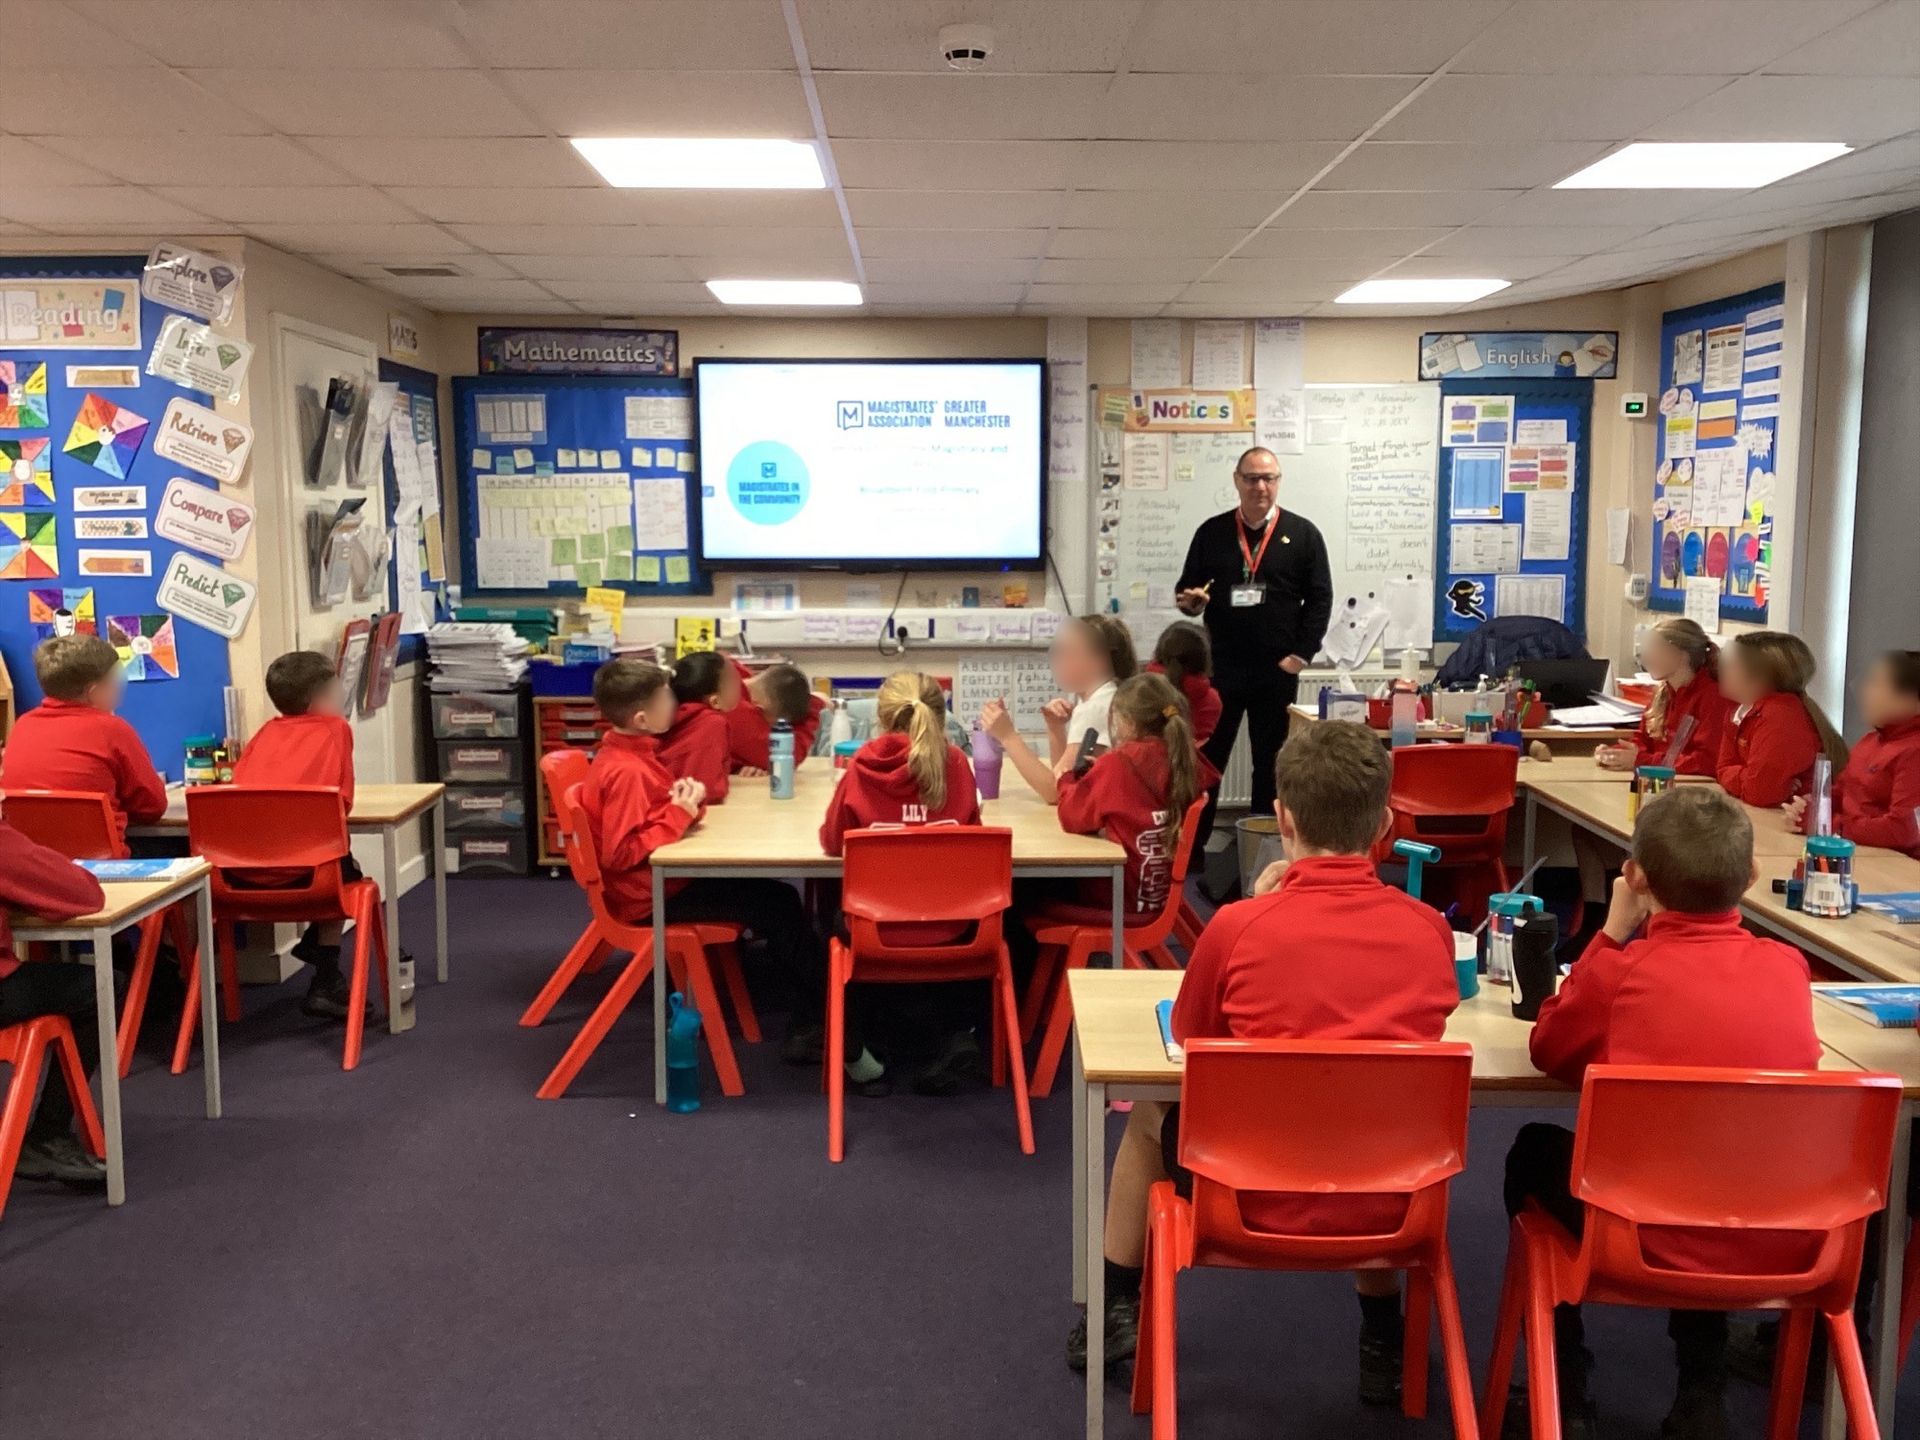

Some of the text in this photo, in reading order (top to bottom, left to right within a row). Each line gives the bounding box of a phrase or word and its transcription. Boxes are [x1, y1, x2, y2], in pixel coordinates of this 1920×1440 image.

[12, 302, 119, 333] Reading
[504, 338, 656, 363] Mathematics
[1486, 348, 1551, 370] English
[868, 400, 938, 413] MAGISTRATES'
[944, 400, 987, 413] GREATER
[1153, 400, 1229, 419] Notices
[170, 411, 218, 446] Retrieve
[868, 415, 932, 427] ASSOCIATION
[944, 415, 1011, 427] MANCHESTER
[170, 489, 224, 525] Compare
[174, 563, 220, 598] Predict
[902, 804, 928, 822] LILY
